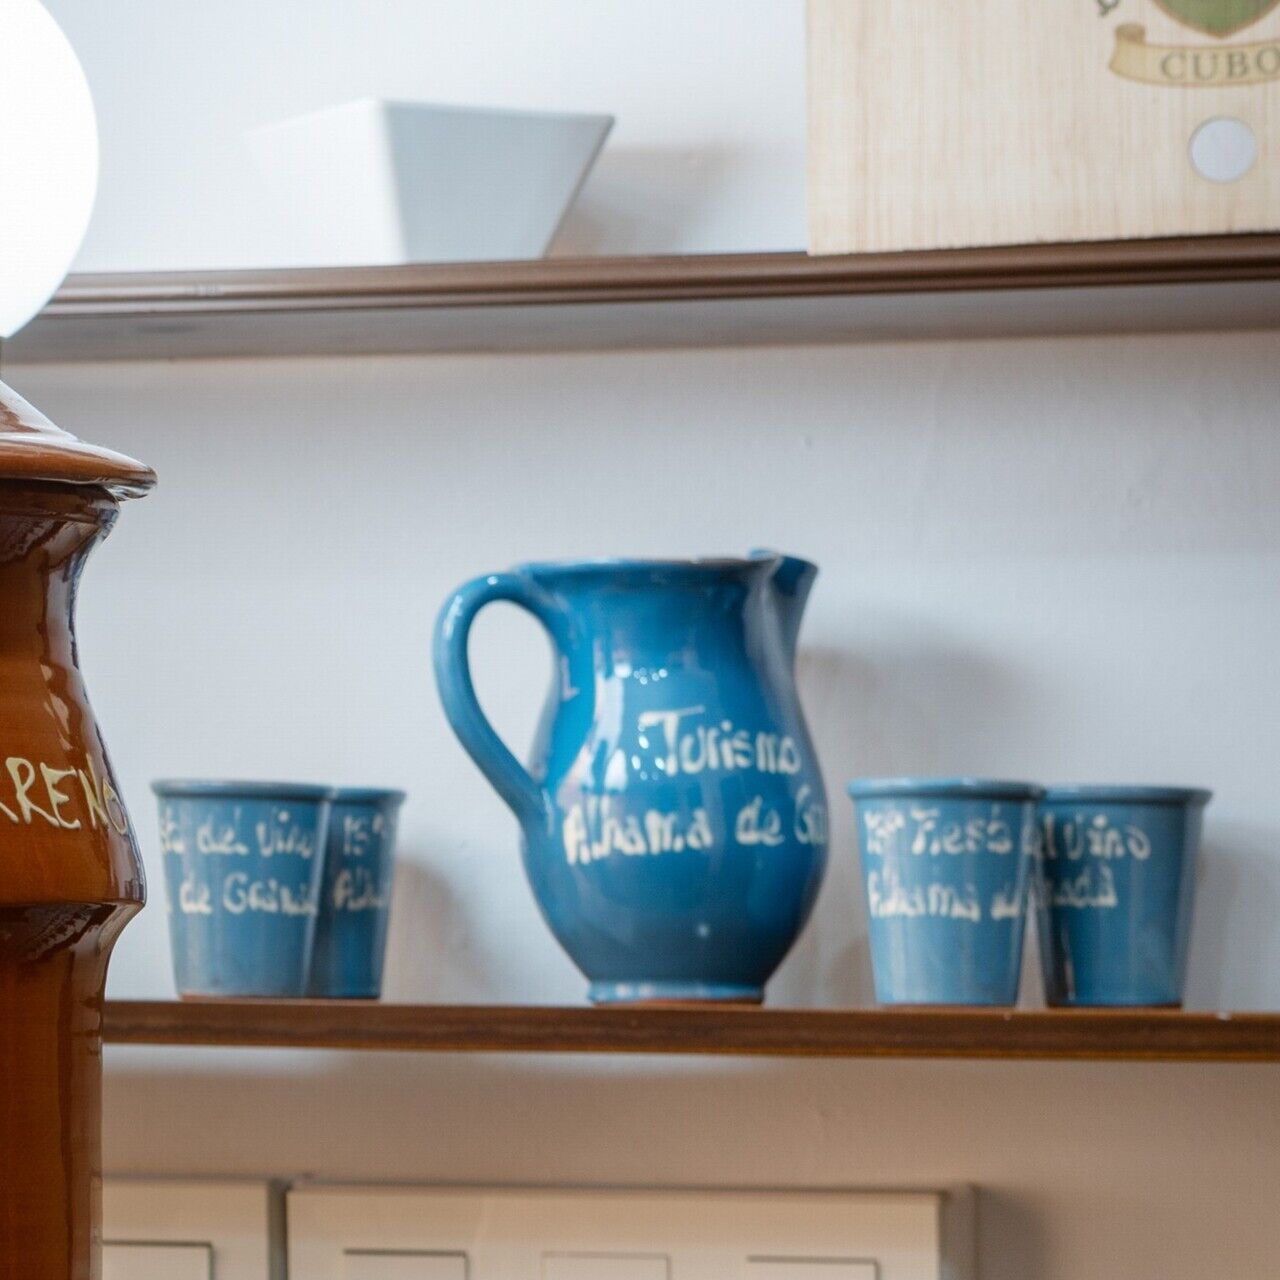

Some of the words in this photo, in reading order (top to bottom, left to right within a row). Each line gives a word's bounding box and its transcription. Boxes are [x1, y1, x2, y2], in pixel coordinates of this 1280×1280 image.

[1160, 47, 1280, 80] CUBO
[638, 705, 802, 777] Turismo
[736, 795, 785, 847] de
